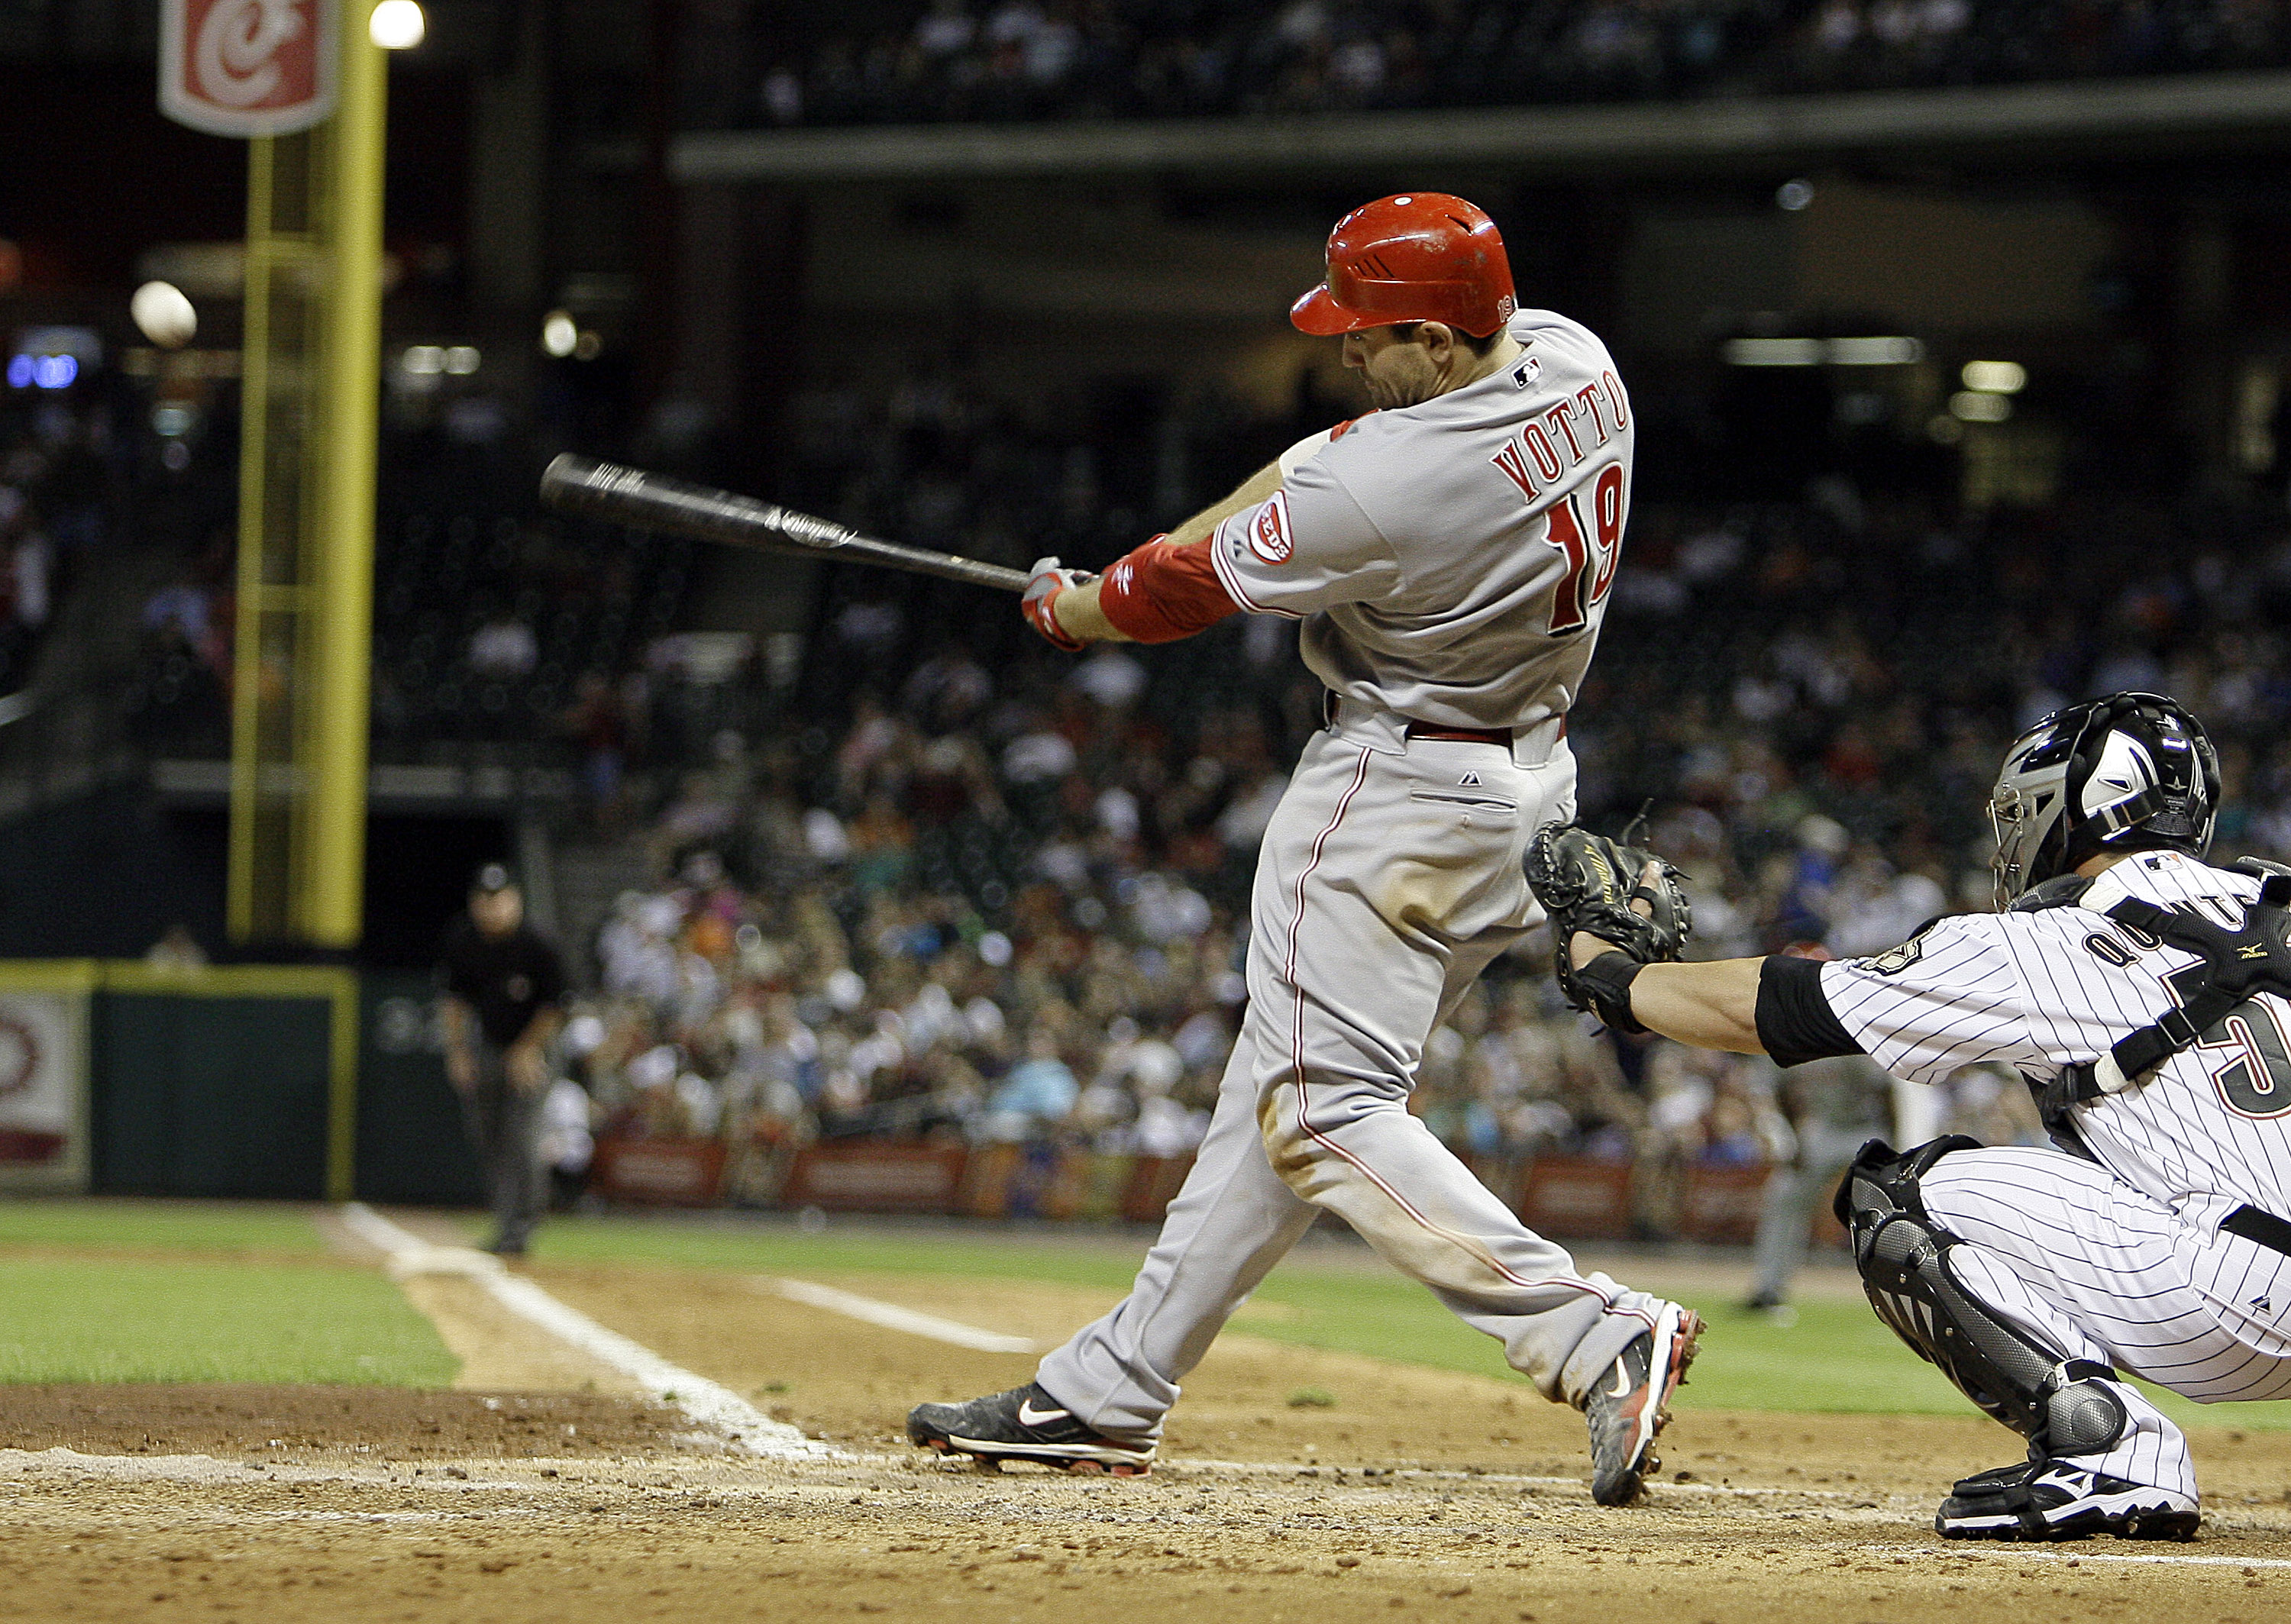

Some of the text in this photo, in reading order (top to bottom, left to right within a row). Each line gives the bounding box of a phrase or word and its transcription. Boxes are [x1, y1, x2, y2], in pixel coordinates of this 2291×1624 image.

[1498, 295, 1512, 323] 19
[1489, 369, 1627, 505] VOTTO
[1540, 460, 1625, 636] 19
